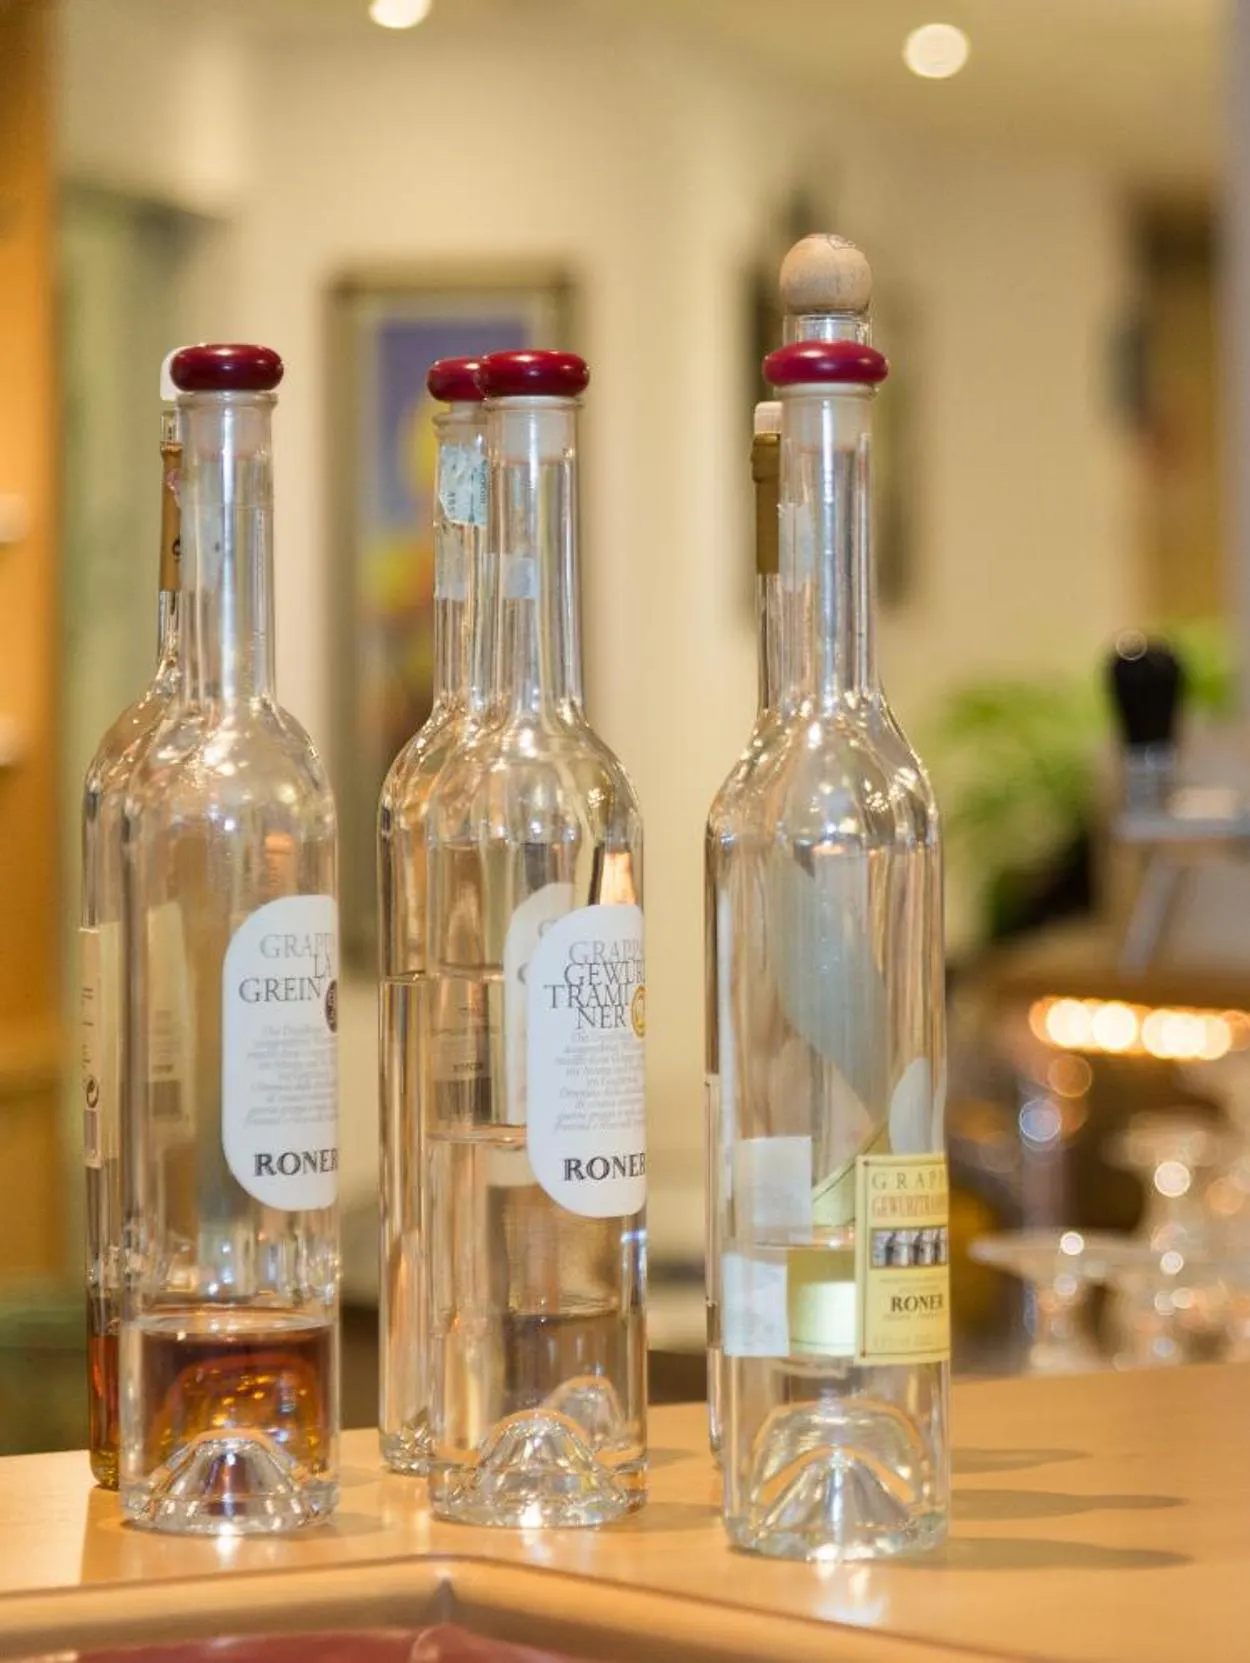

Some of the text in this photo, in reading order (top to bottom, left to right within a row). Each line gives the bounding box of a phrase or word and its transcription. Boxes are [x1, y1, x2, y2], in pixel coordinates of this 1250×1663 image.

[238, 977, 322, 1003] GREIN
[576, 1004, 627, 1029] NER
[253, 1149, 338, 1177] RONER
[563, 1153, 646, 1181] RONER
